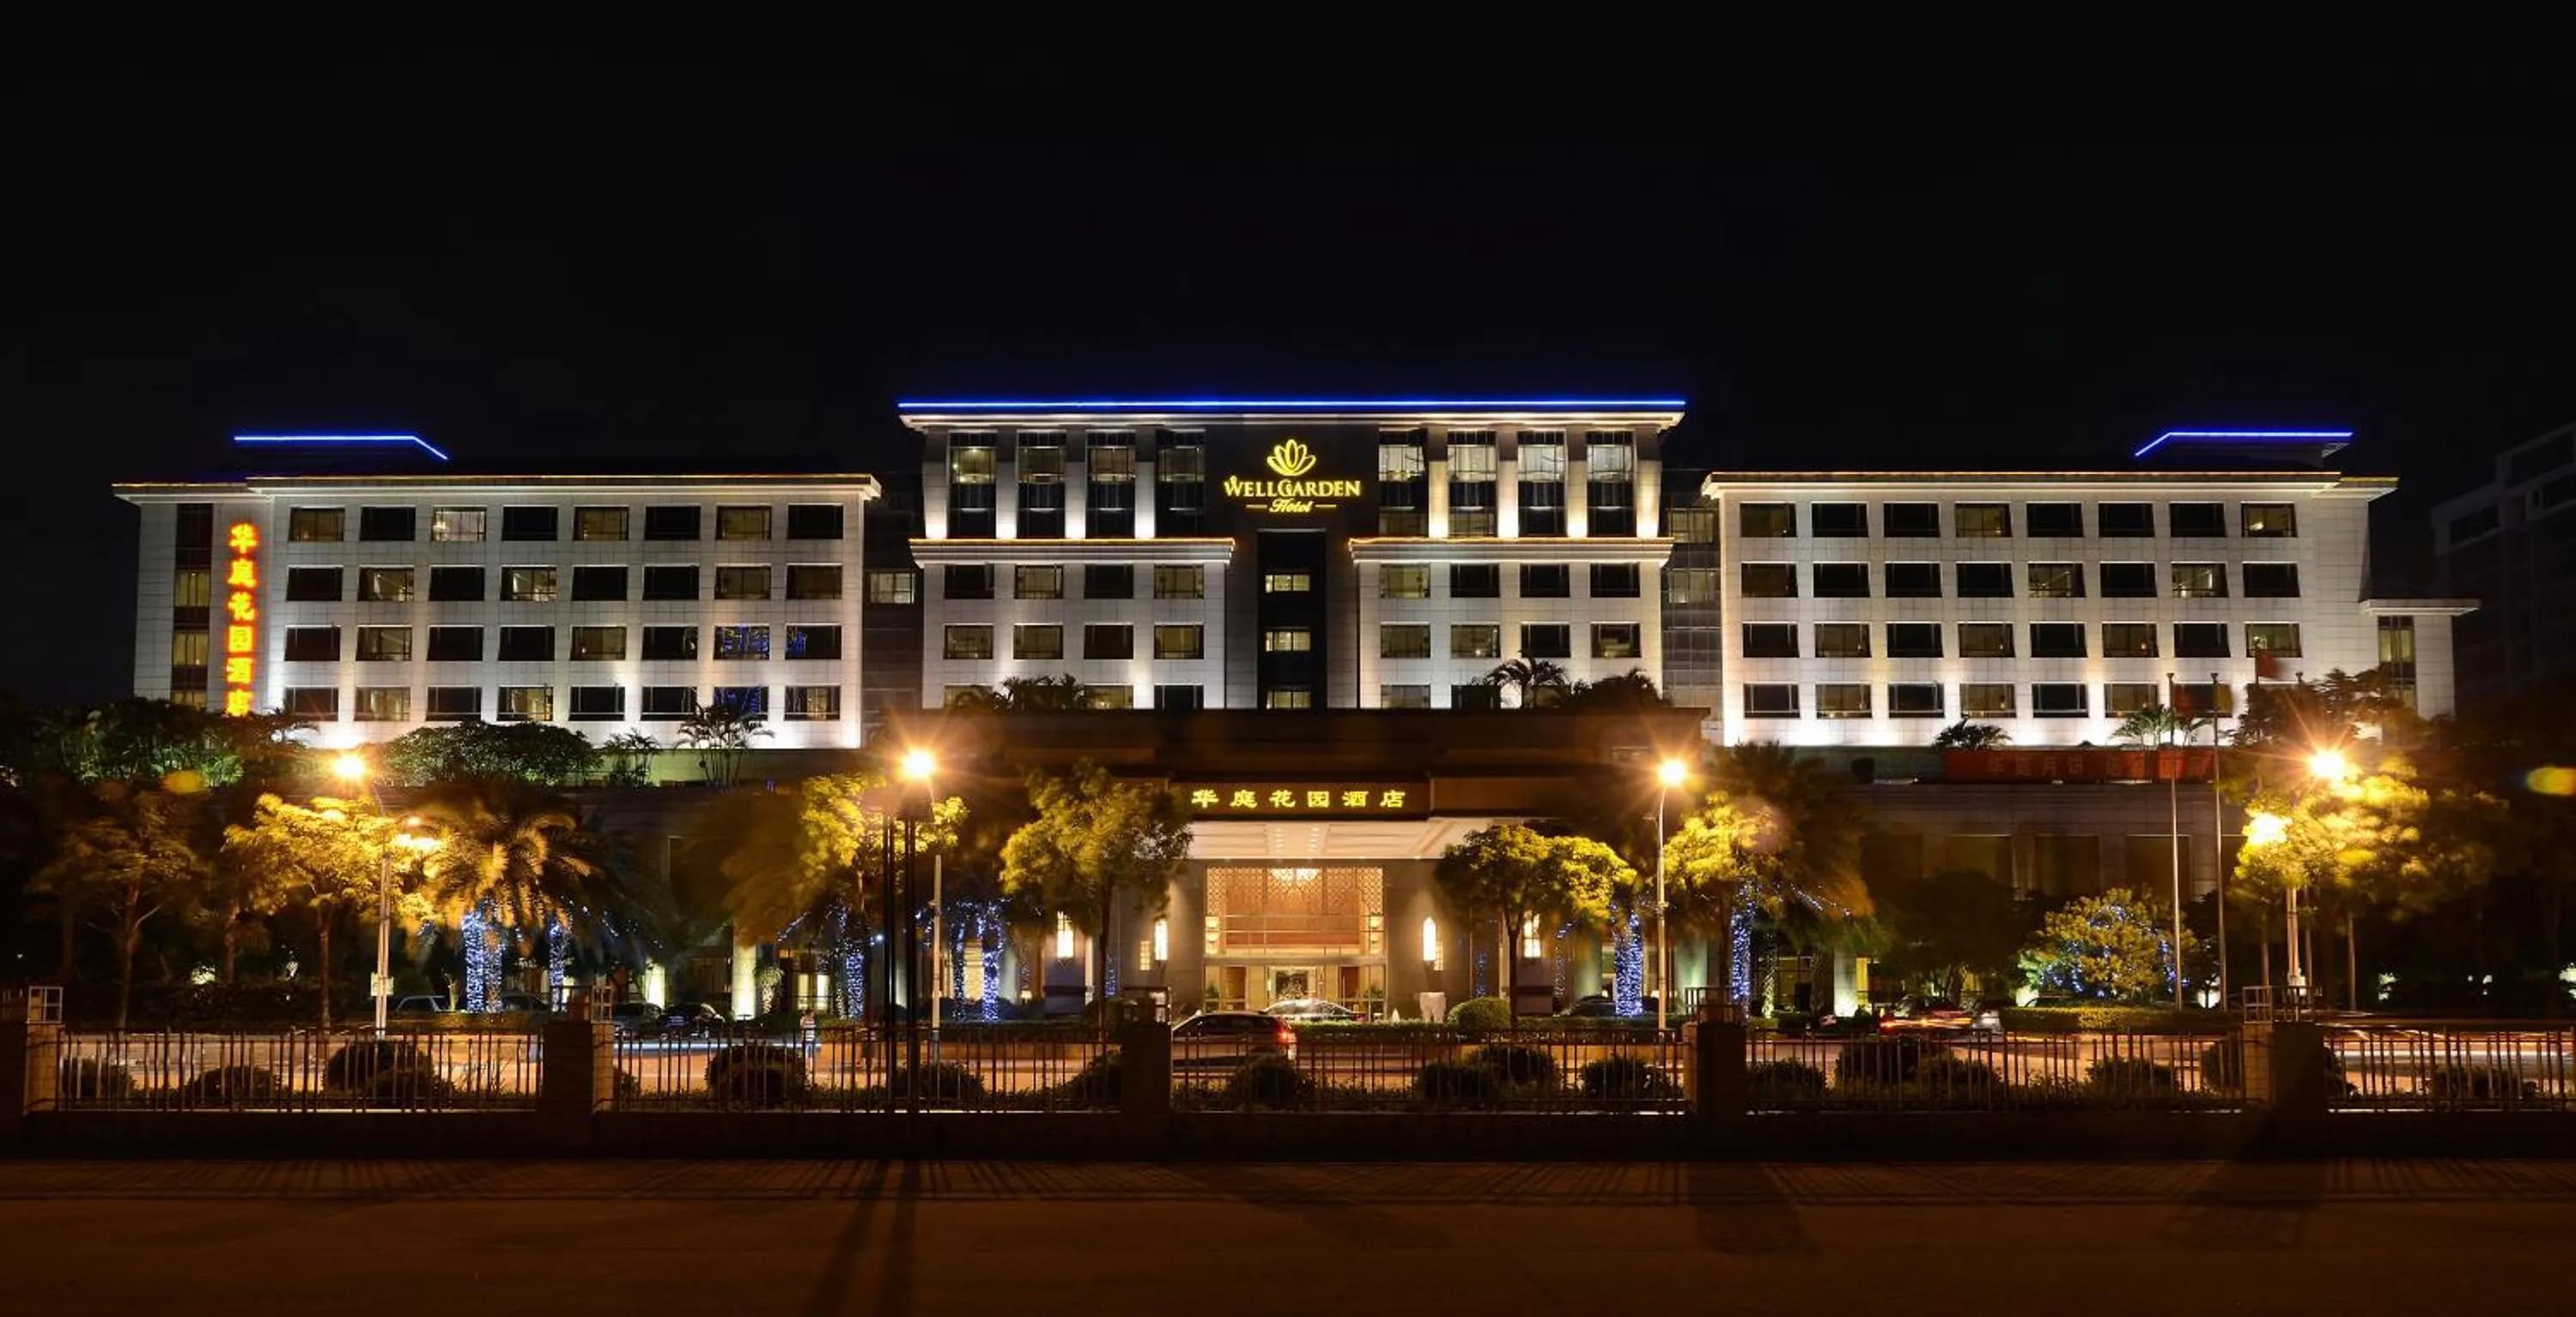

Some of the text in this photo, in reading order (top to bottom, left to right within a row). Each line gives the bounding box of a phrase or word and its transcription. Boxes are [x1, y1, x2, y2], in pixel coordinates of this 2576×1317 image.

[1224, 475, 1361, 497] WELLGARDEN
[1269, 497, 1314, 513] Hotel
[226, 523, 258, 718] 华庭花园酒店
[1191, 789, 1406, 809] 华庭花园酒店
